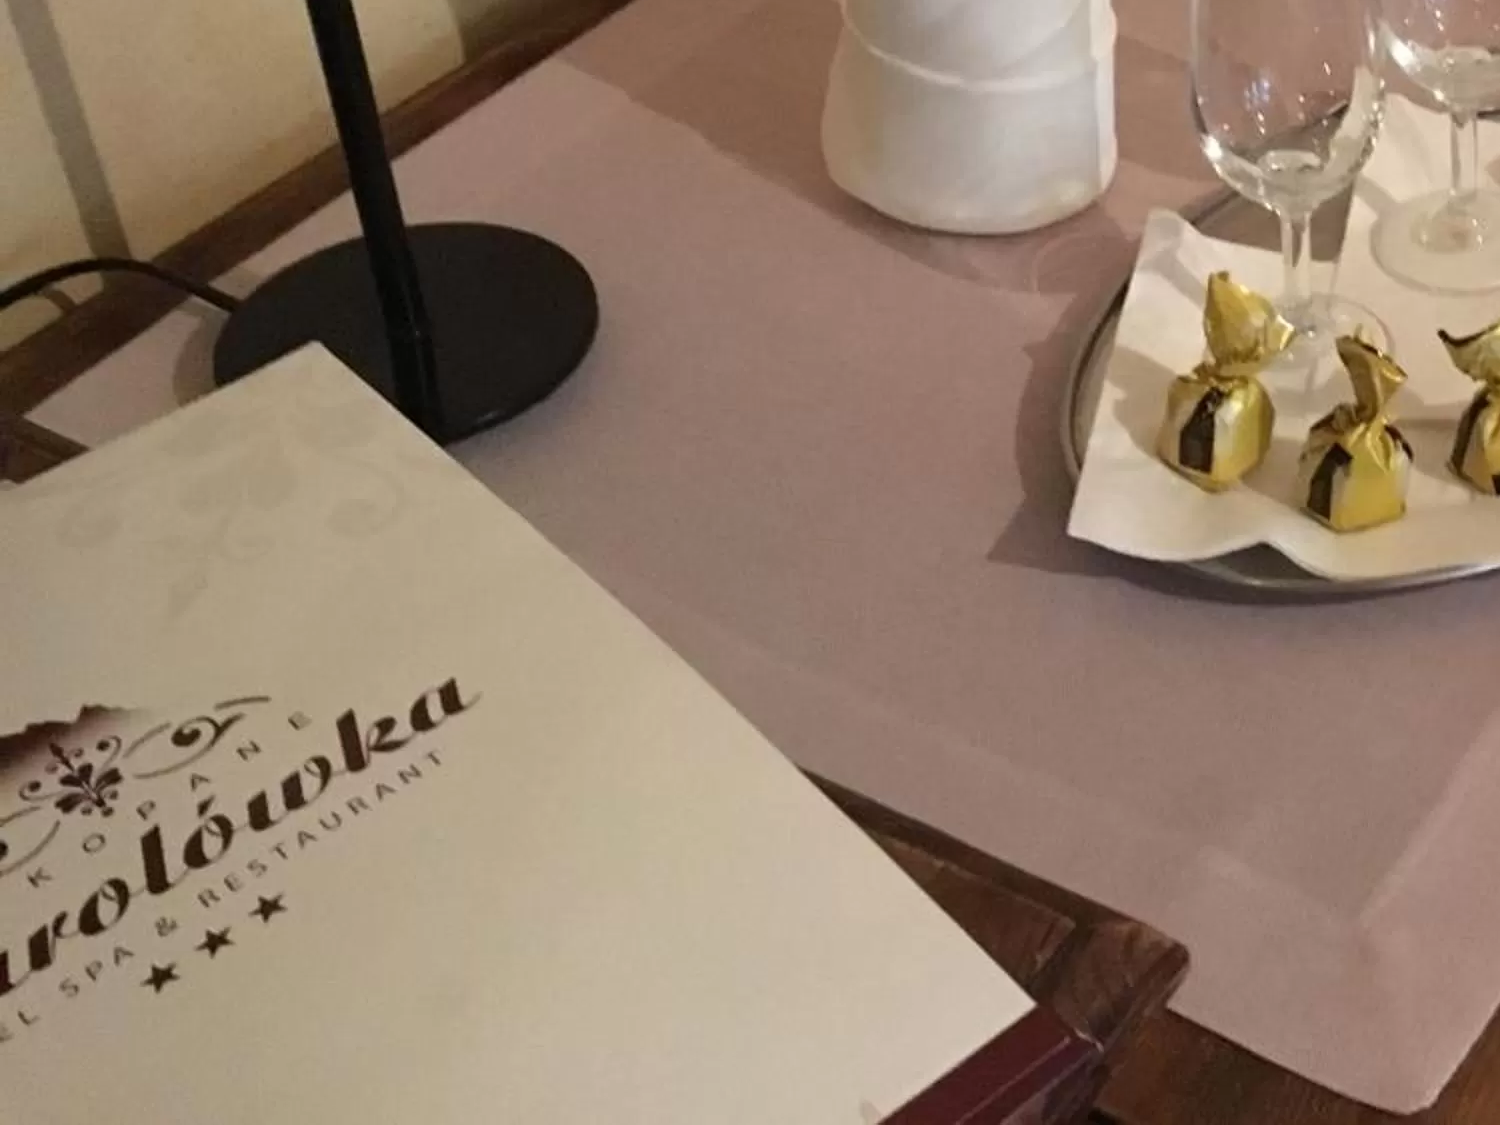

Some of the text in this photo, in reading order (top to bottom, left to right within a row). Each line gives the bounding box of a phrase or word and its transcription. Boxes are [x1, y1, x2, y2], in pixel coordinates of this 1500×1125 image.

[59, 946, 135, 997] SPA
[155, 916, 180, 937] &
[197, 749, 442, 909] RESTAURANT
